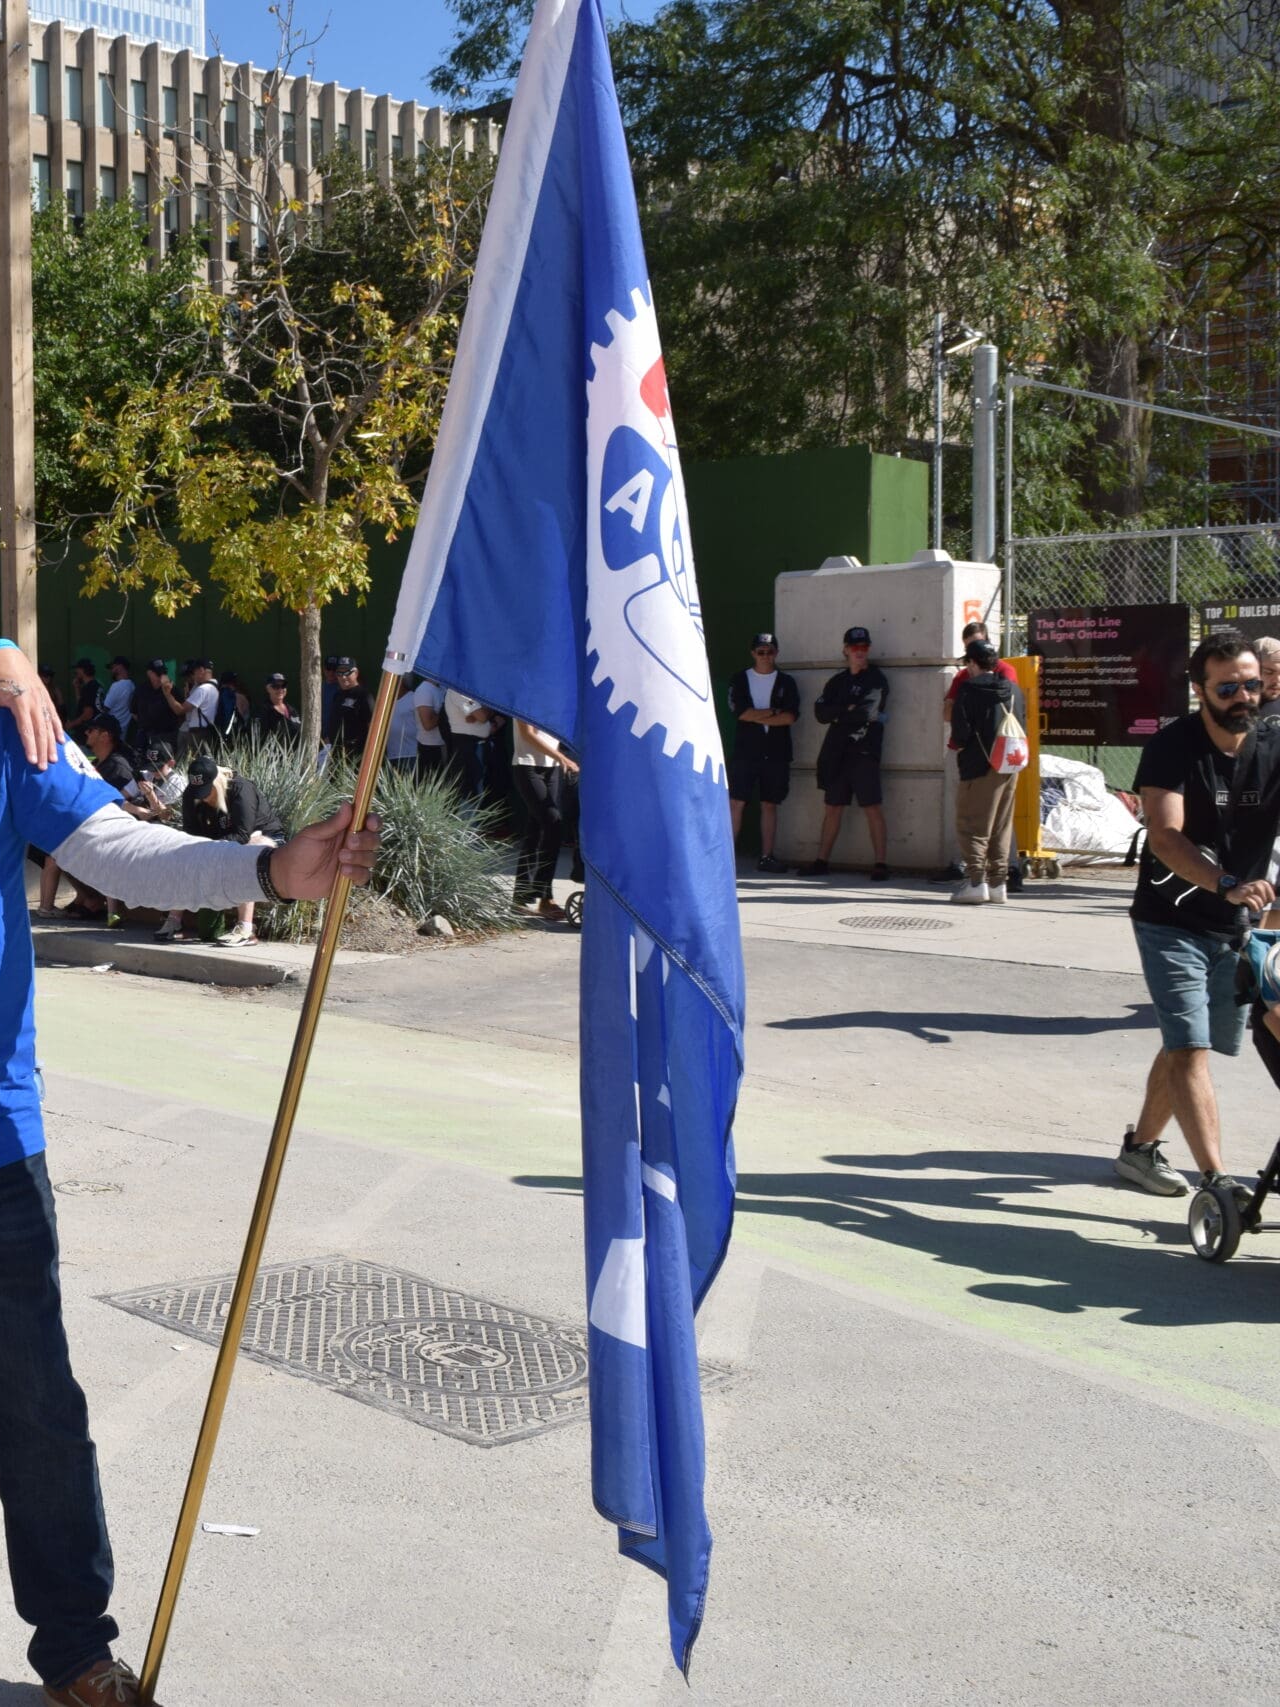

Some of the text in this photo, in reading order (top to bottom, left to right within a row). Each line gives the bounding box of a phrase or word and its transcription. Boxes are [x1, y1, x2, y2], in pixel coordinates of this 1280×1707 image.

[604, 468, 655, 534] A
[1205, 607, 1223, 619] TOP
[1224, 605, 1238, 618] 10
[1239, 605, 1268, 618] RULES
[1037, 617, 1121, 629] The Ontario Line
[1036, 629, 1118, 643] La ligne Ontario
[1050, 728, 1096, 736] METROLINX
